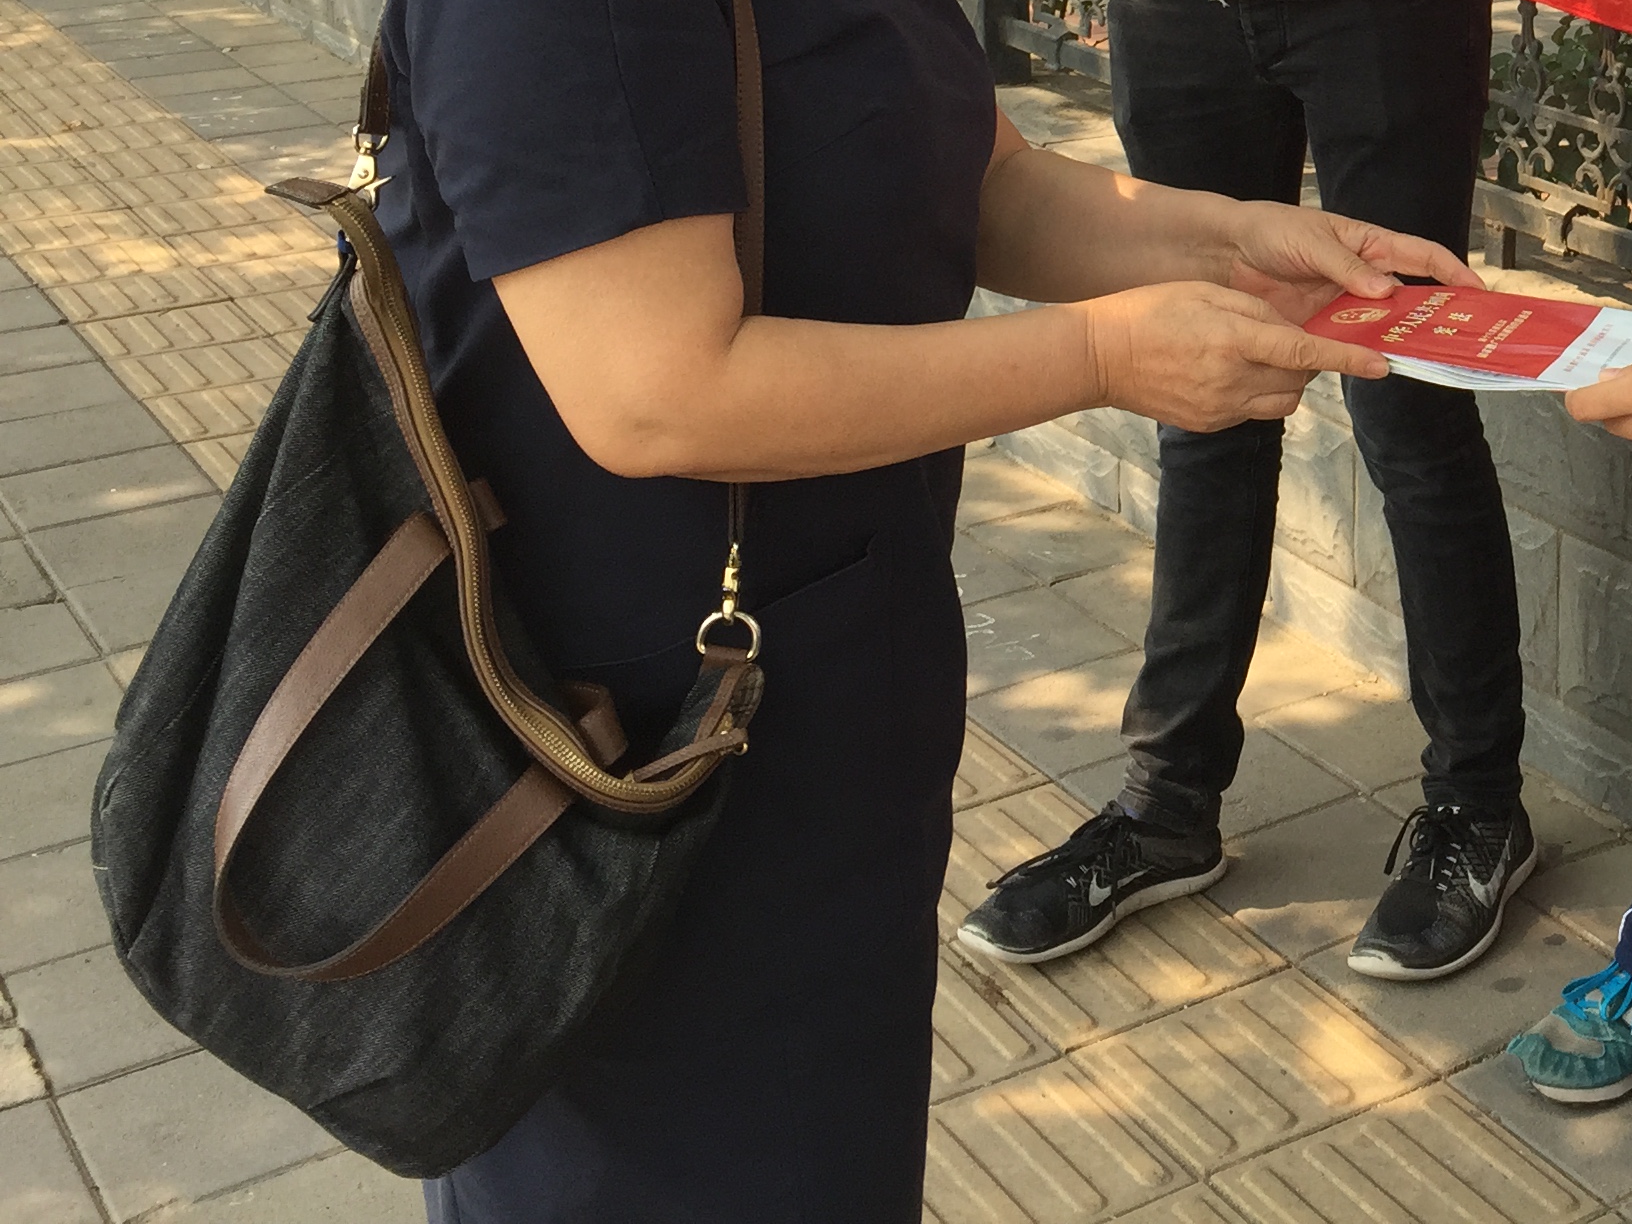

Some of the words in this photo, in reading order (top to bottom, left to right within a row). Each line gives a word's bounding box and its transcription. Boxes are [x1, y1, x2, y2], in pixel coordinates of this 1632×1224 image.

[1380, 291, 1457, 343] 中华人民共和国
